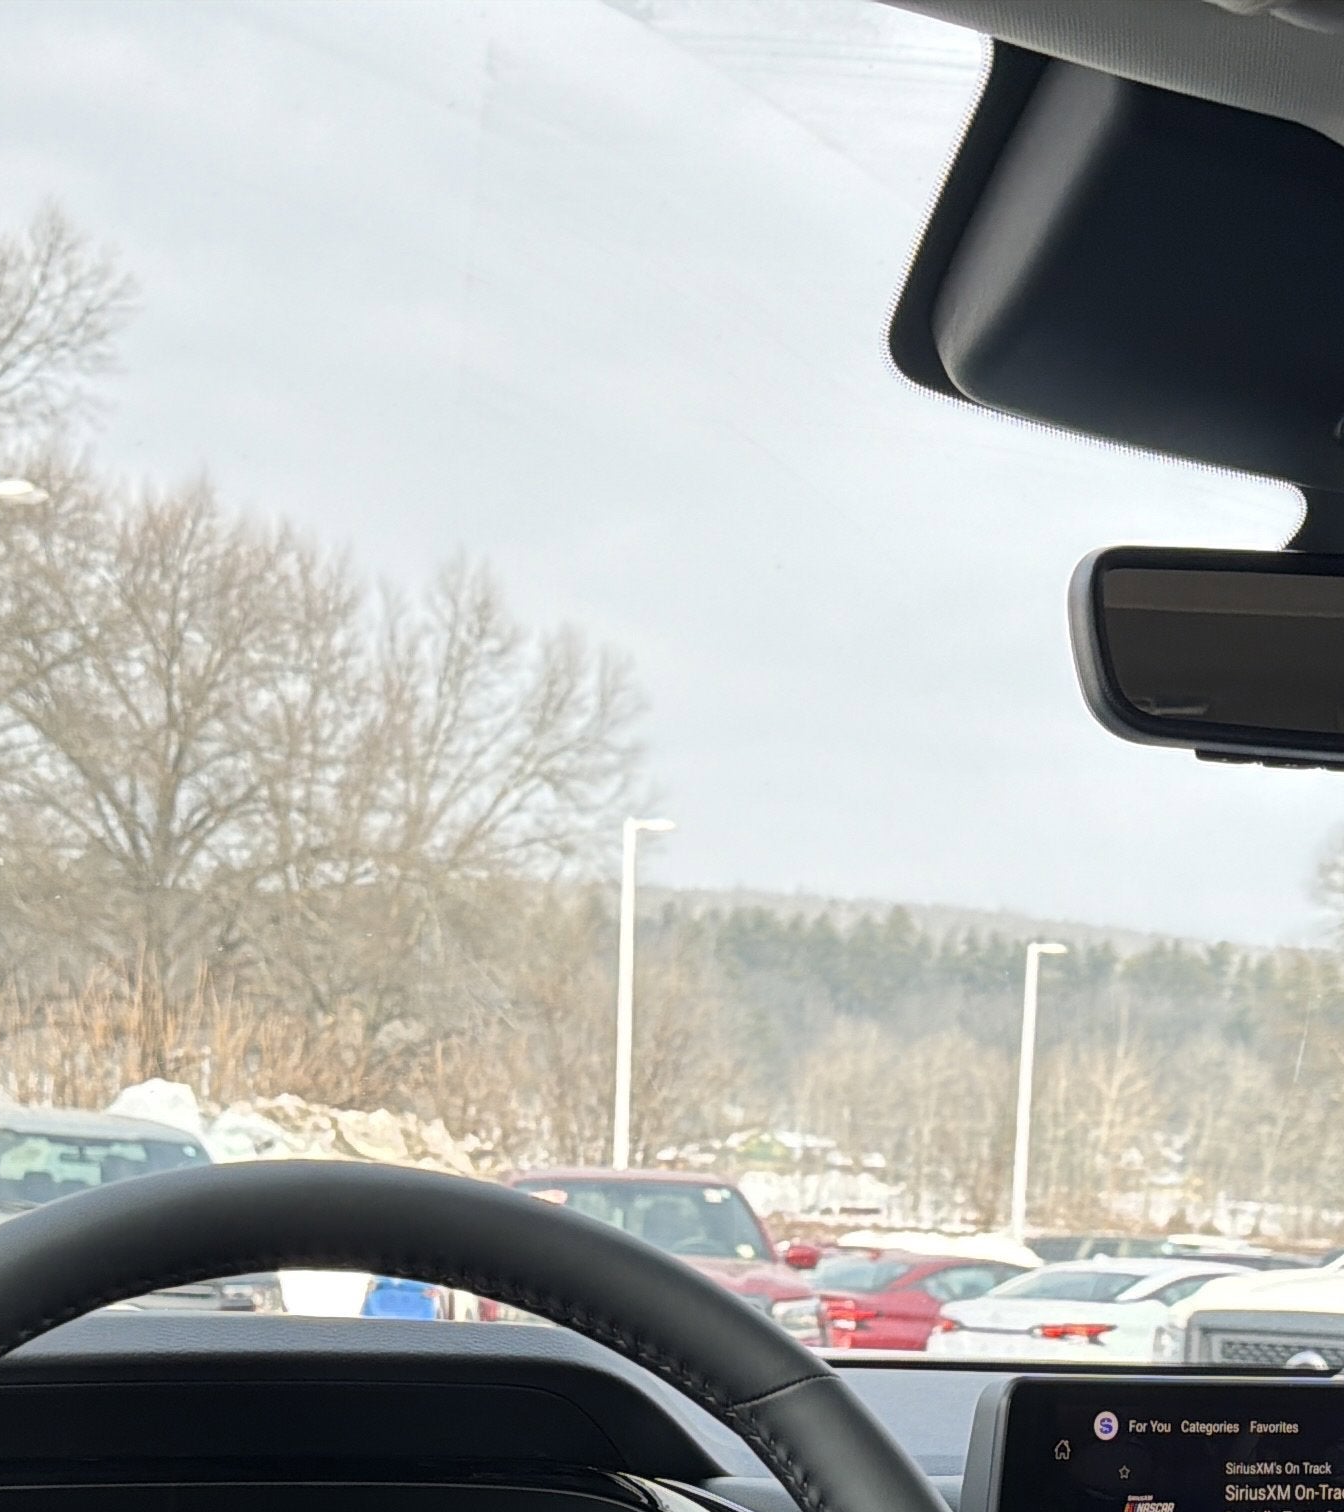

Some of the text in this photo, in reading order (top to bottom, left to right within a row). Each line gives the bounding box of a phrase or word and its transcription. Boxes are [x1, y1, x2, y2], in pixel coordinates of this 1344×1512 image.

[1129, 1420, 1172, 1433] For You
[1181, 1420, 1240, 1435] Categories
[1250, 1421, 1299, 1433] Favorites
[1225, 1462, 1332, 1475] SiriusXM's On Track
[1225, 1484, 1291, 1501] SiriusXM
